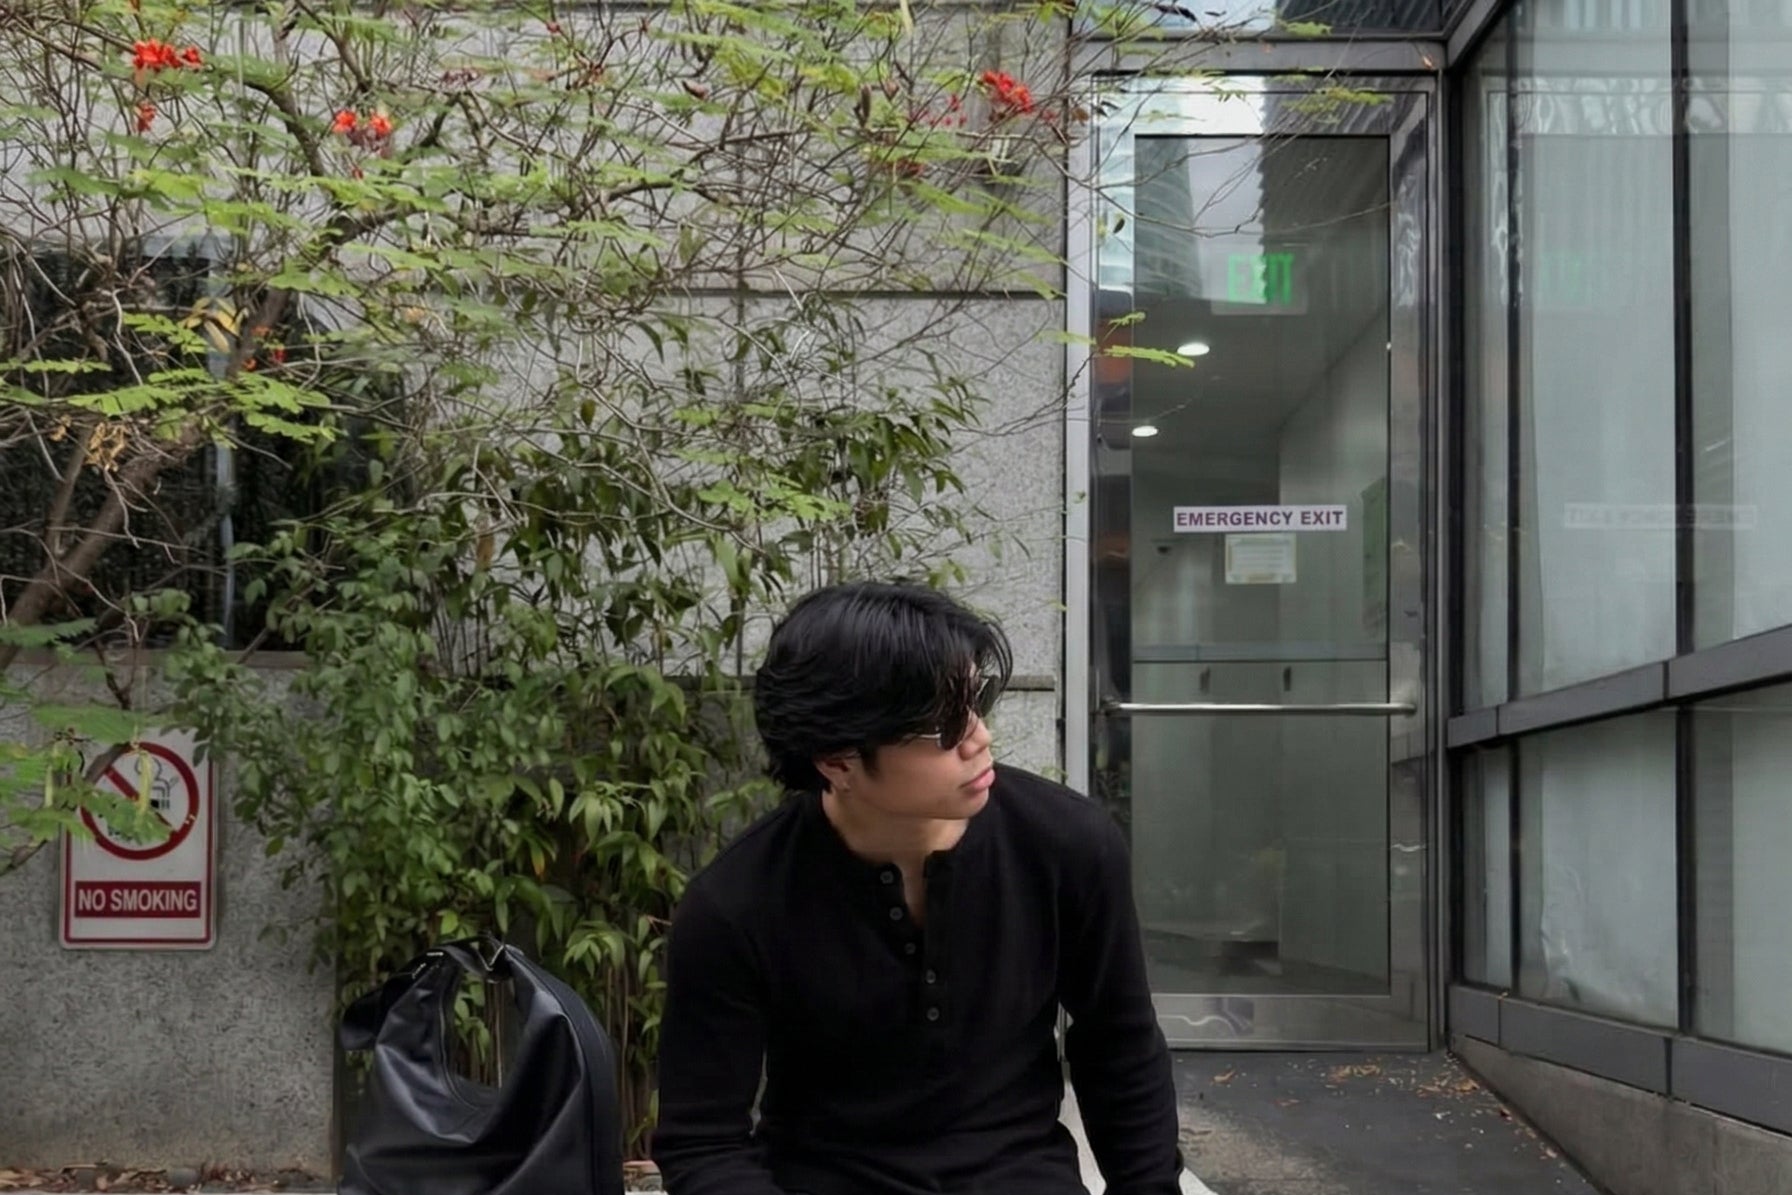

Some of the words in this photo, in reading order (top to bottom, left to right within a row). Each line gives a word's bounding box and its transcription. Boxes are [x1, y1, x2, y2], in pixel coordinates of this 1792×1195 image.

[1177, 512, 1293, 526] EMERGENCY
[1301, 511, 1344, 525] EXIT
[78, 889, 105, 911] NO
[110, 889, 197, 911] SMOKING
